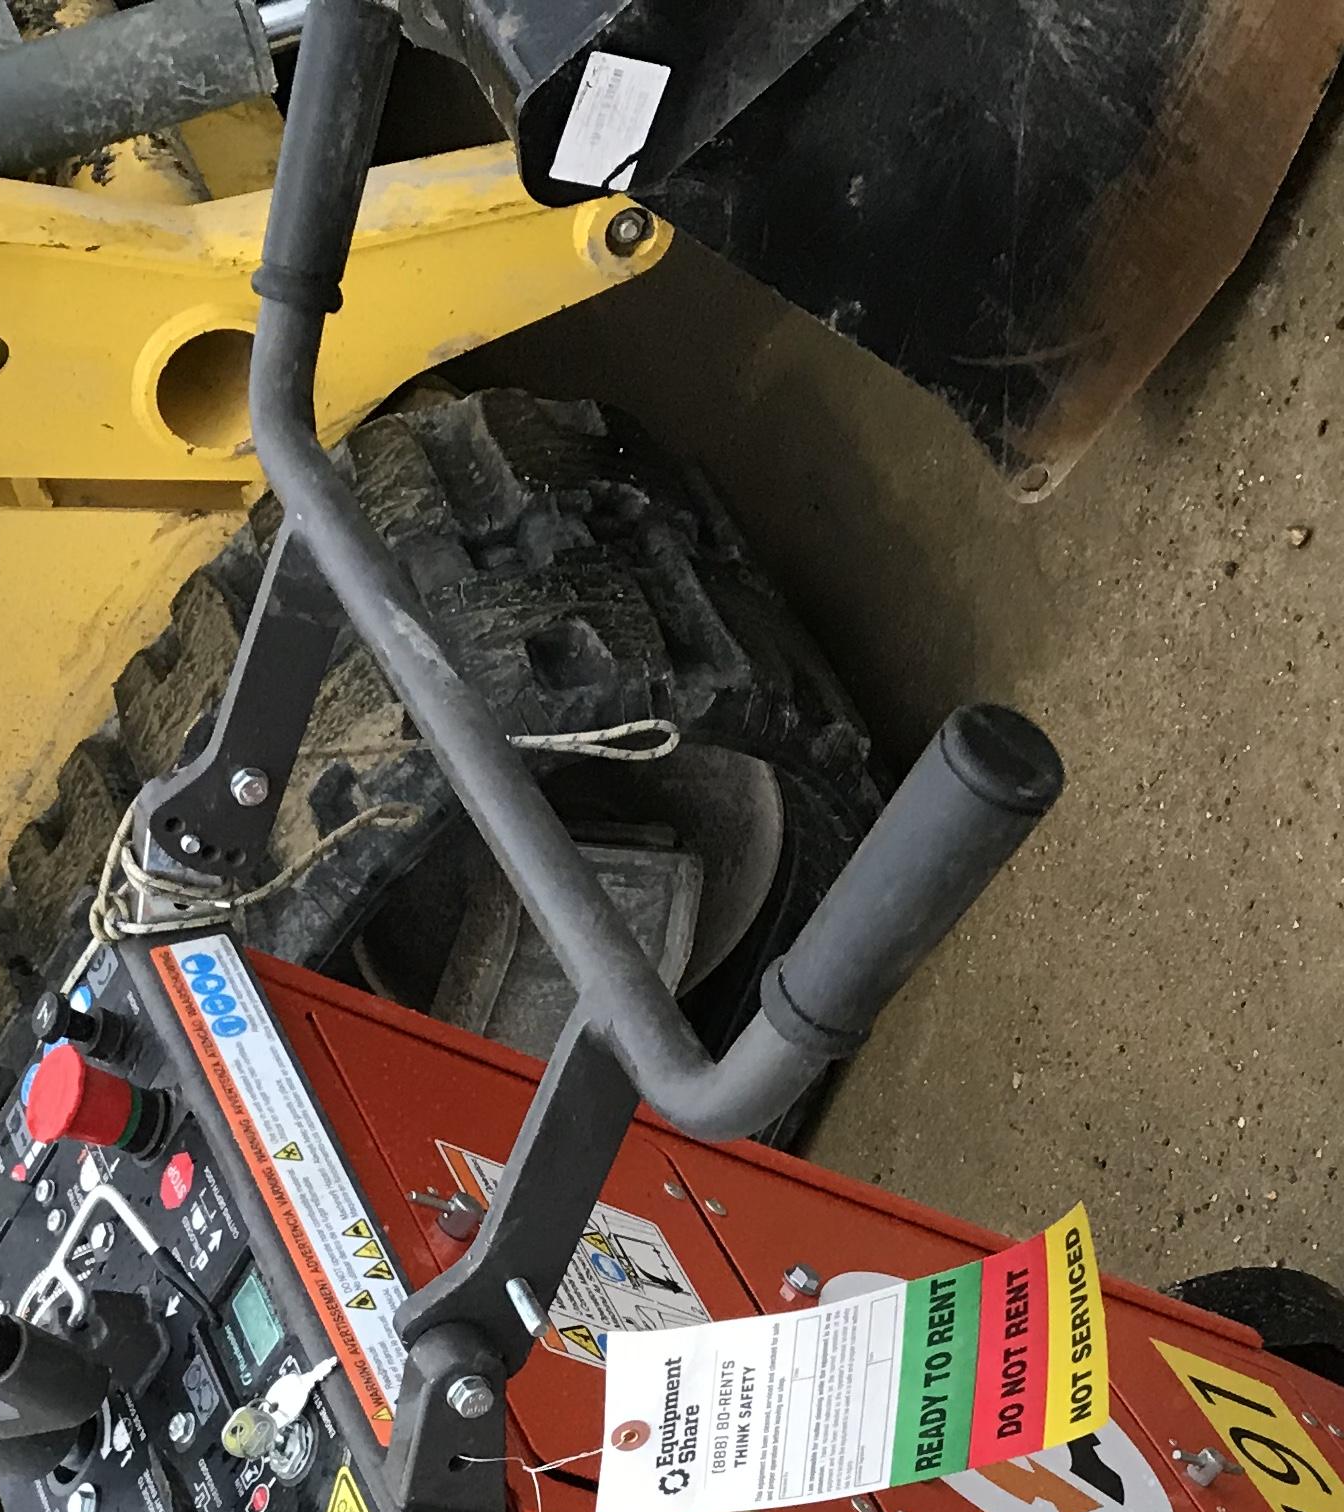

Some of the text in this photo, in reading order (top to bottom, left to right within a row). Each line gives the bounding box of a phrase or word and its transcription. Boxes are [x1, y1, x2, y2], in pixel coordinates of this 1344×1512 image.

[166, 1160, 187, 1202] STOP
[281, 1209, 321, 1277] ADVERTENCIA
[313, 1277, 360, 1359] AVERTISSEMENT
[996, 1268, 1029, 1439] DO NOT RENT
[1064, 1226, 1092, 1424] NOT SERVICED
[353, 1359, 384, 1409] WARNING
[656, 1356, 682, 1468] Equipment
[712, 1360, 735, 1474] (888) 80-RENTS
[734, 1366, 756, 1468] THINK SAFETY
[914, 1278, 957, 1472] READY TO RENT
[678, 1405, 699, 1464] Share
